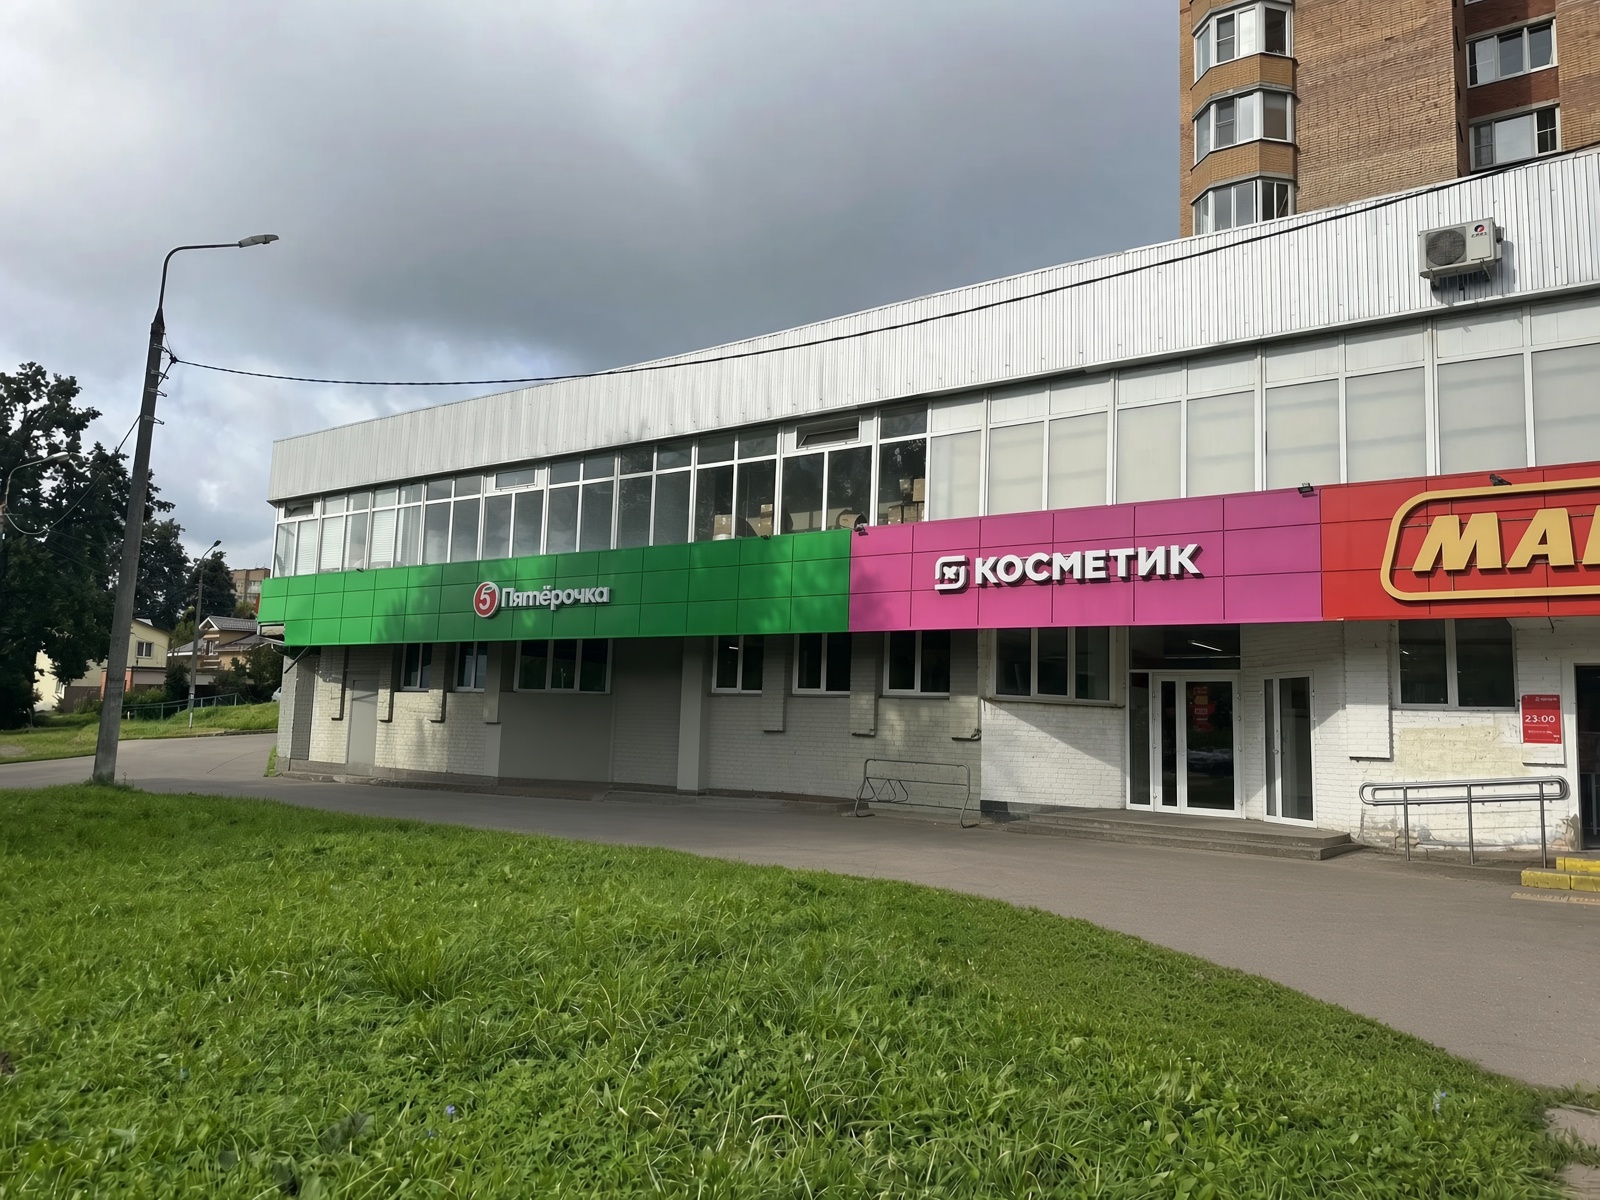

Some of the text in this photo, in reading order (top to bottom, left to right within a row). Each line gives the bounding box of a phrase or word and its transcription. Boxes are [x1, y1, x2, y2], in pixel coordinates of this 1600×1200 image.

[1412, 505, 1600, 572] МА
[975, 544, 1201, 584] КОСМЕТИК
[501, 585, 610, 611] Пятёрочка
